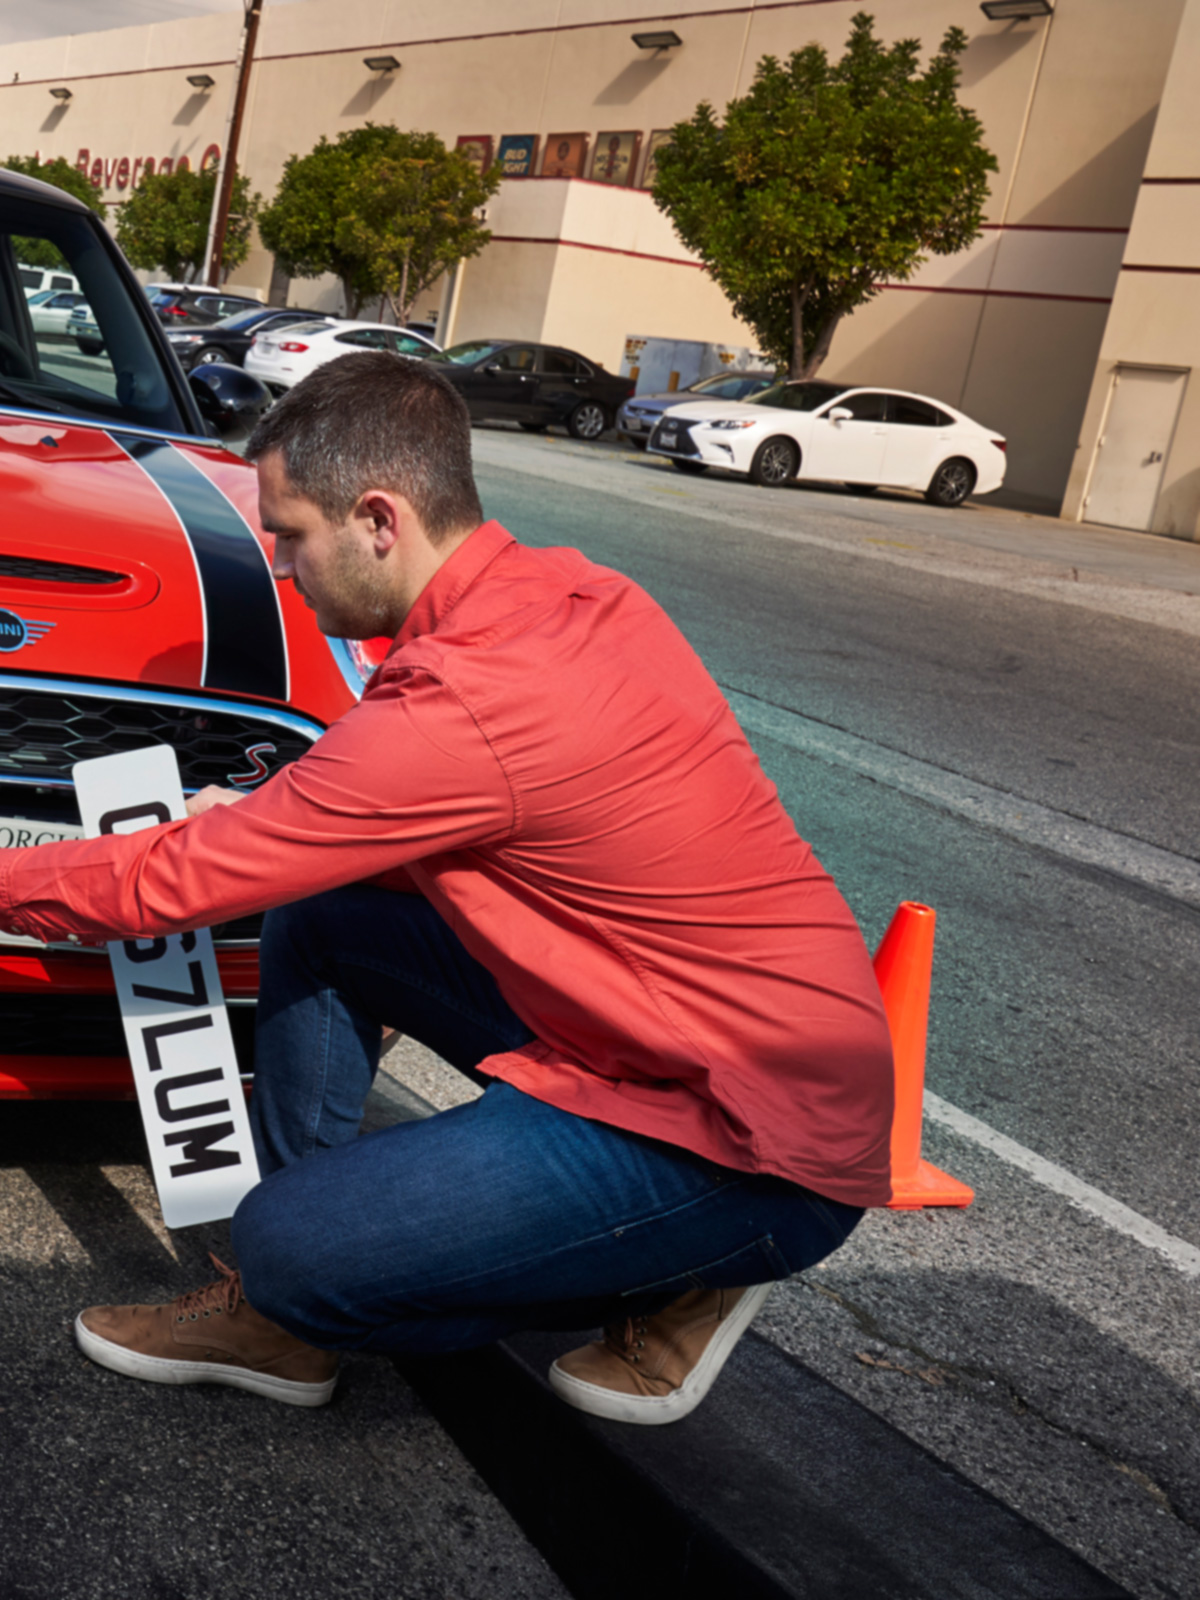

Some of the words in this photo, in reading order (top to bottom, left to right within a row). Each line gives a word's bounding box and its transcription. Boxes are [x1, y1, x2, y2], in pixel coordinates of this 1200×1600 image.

[504, 149, 527, 161] BUD
[501, 162, 528, 174] IGHT
[227, 742, 276, 786] S
